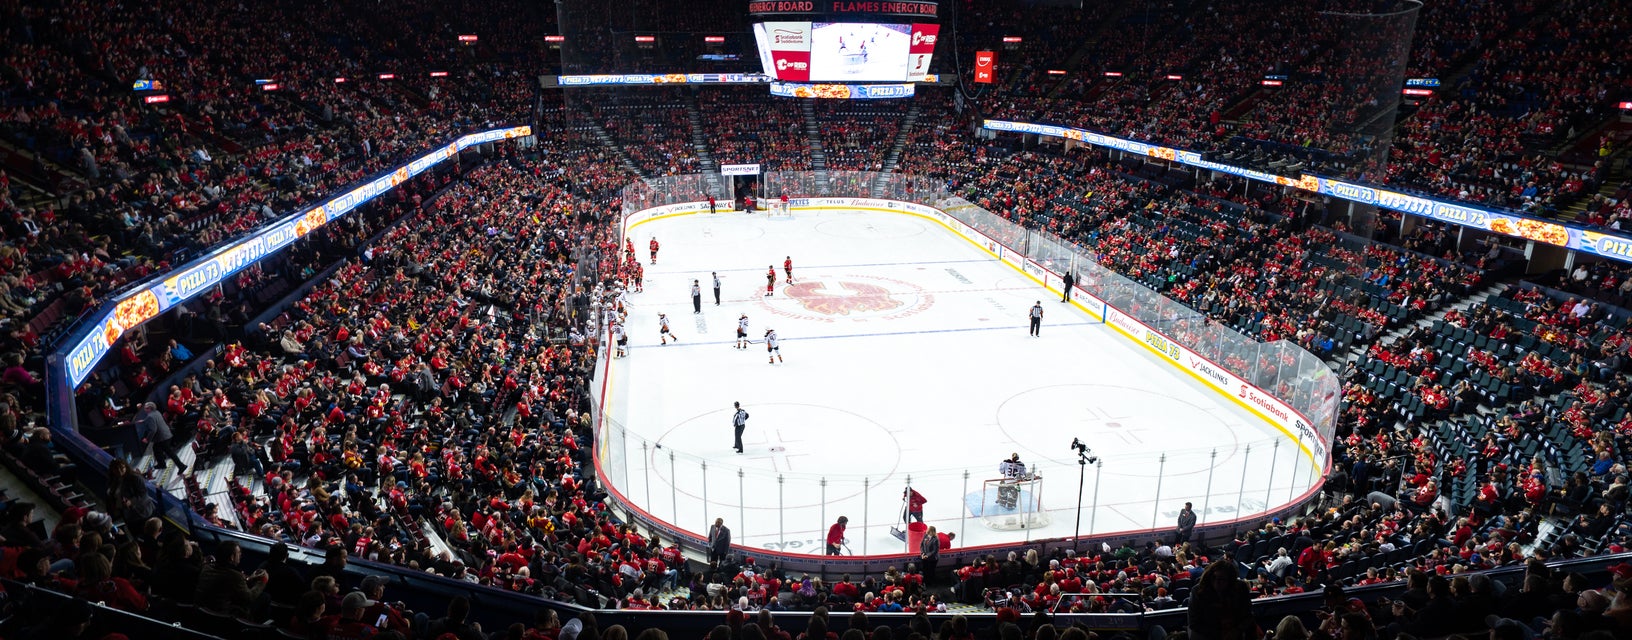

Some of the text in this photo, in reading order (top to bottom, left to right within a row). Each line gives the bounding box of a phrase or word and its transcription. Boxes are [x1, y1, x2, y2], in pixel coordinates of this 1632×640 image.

[778, 1, 813, 12] BOARD
[833, 3, 937, 14] FLAMES ENERGY BOARD
[871, 87, 894, 96] PIZZA
[850, 199, 884, 207] Budweiser
[1337, 184, 1359, 199] PIZZA
[1361, 188, 1372, 201] 73
[1439, 205, 1468, 222] PIZZA
[1471, 212, 1485, 226] 73
[73, 341, 95, 377] PIZZA
[180, 272, 206, 294] PIZZA
[206, 263, 219, 280] 73
[267, 231, 285, 250] PIZZA
[1109, 311, 1140, 335] Budweiser
[1146, 330, 1181, 360] PIZZA 73
[1200, 363, 1213, 376] JACK
[1249, 391, 1289, 422] Scotiabank
